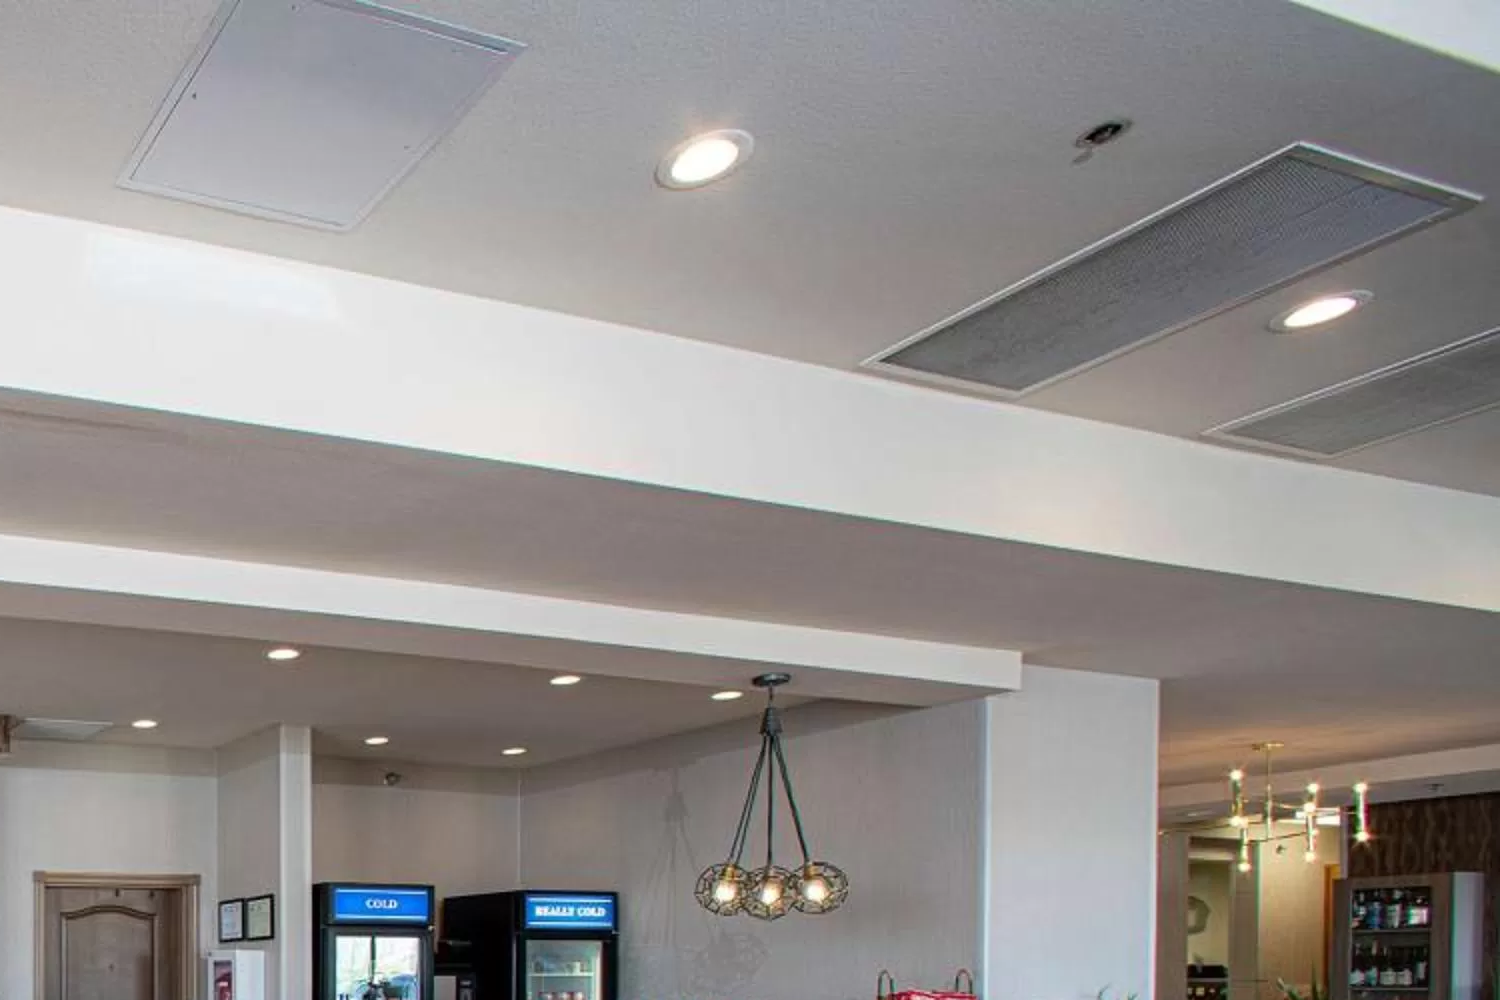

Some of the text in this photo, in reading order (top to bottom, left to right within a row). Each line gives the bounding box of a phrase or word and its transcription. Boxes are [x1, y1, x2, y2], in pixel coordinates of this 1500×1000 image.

[365, 898, 399, 909] COLD
[535, 906, 606, 917] REALLY COLD
